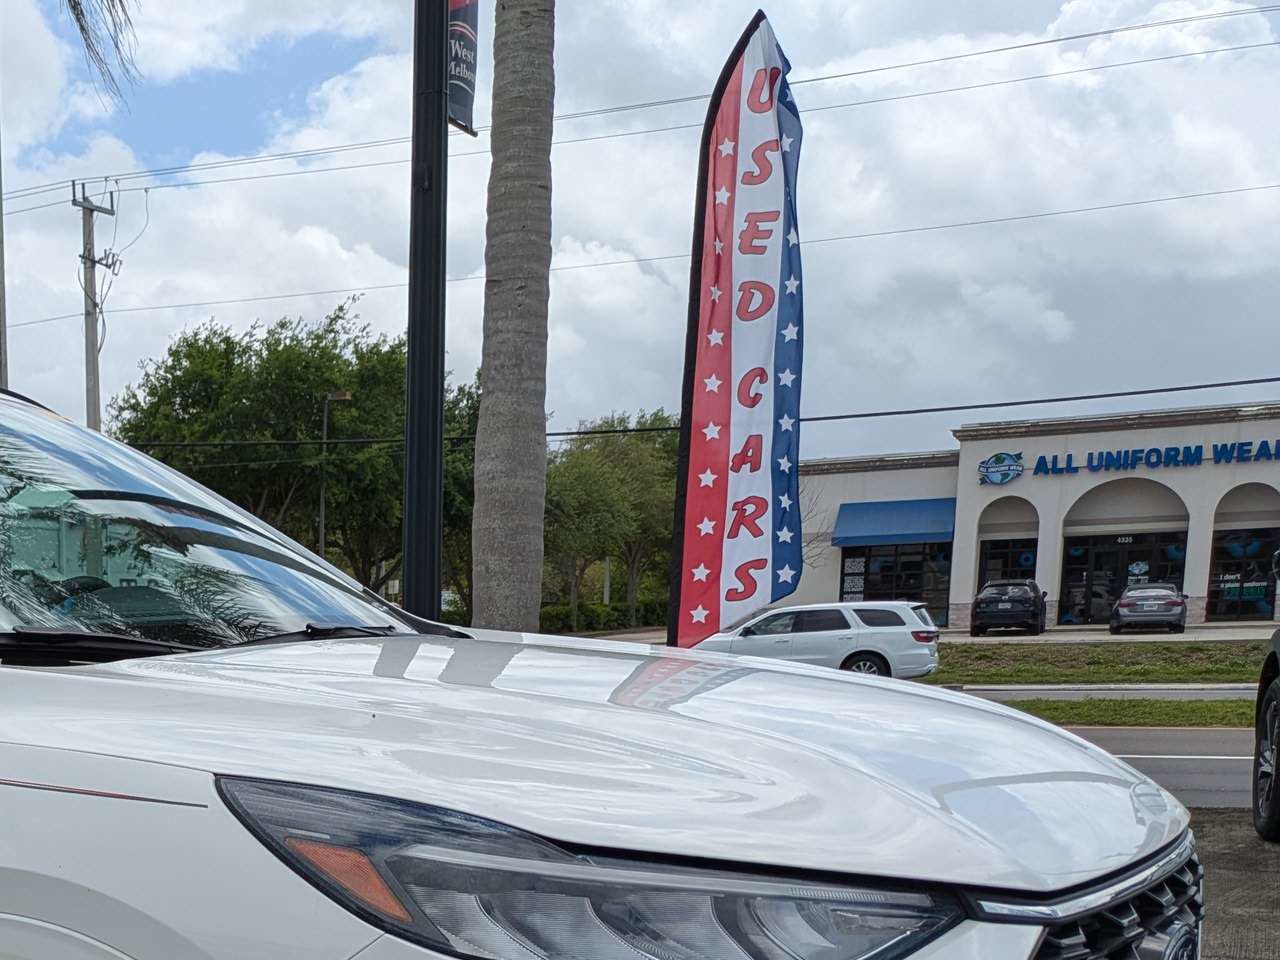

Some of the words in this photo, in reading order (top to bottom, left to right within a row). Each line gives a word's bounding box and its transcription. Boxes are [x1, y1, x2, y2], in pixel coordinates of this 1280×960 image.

[450, 39, 474, 65] West
[736, 67, 781, 321] USED
[725, 366, 769, 601] CARS
[1033, 454, 1079, 475] ALL
[1087, 445, 1203, 472] UNIFORM
[1213, 440, 1280, 464] WEA
